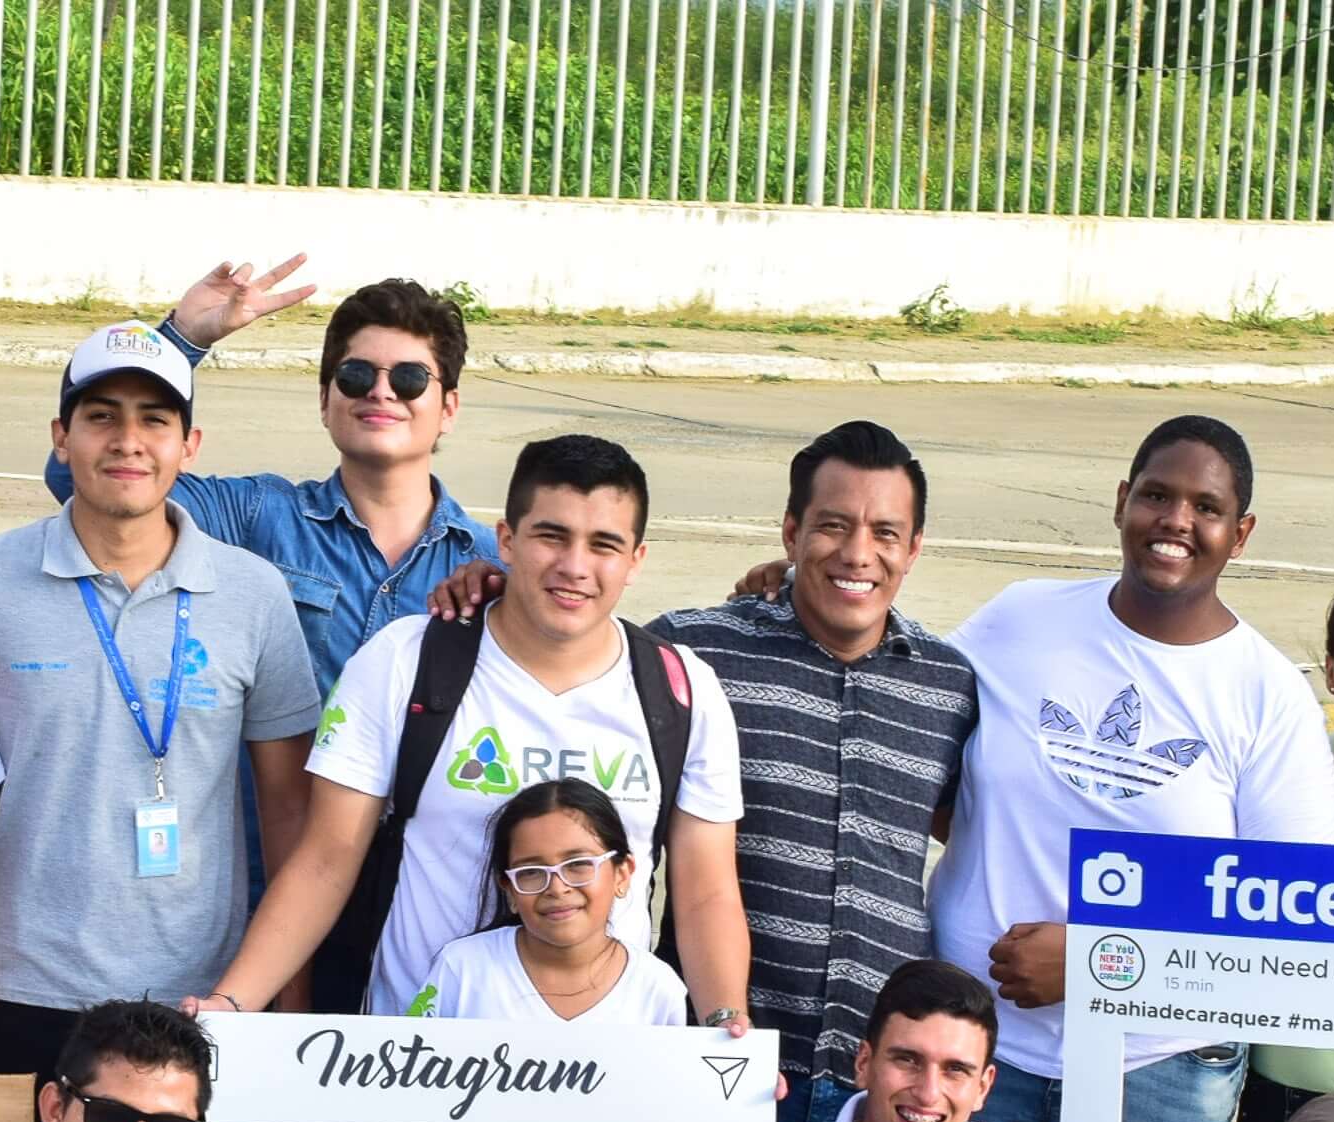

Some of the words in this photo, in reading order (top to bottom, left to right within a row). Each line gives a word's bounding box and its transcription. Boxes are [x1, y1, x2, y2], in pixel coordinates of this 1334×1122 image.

[522, 745, 651, 792] REVA
[1165, 948, 1197, 970] All
[1205, 951, 1252, 974] You
[1261, 955, 1329, 980] Need
[1164, 977, 1179, 991] 15
[1185, 978, 1214, 993] min
[1089, 998, 1281, 1029] #bahiadecaraquez
[297, 1028, 607, 1120] Instagram
